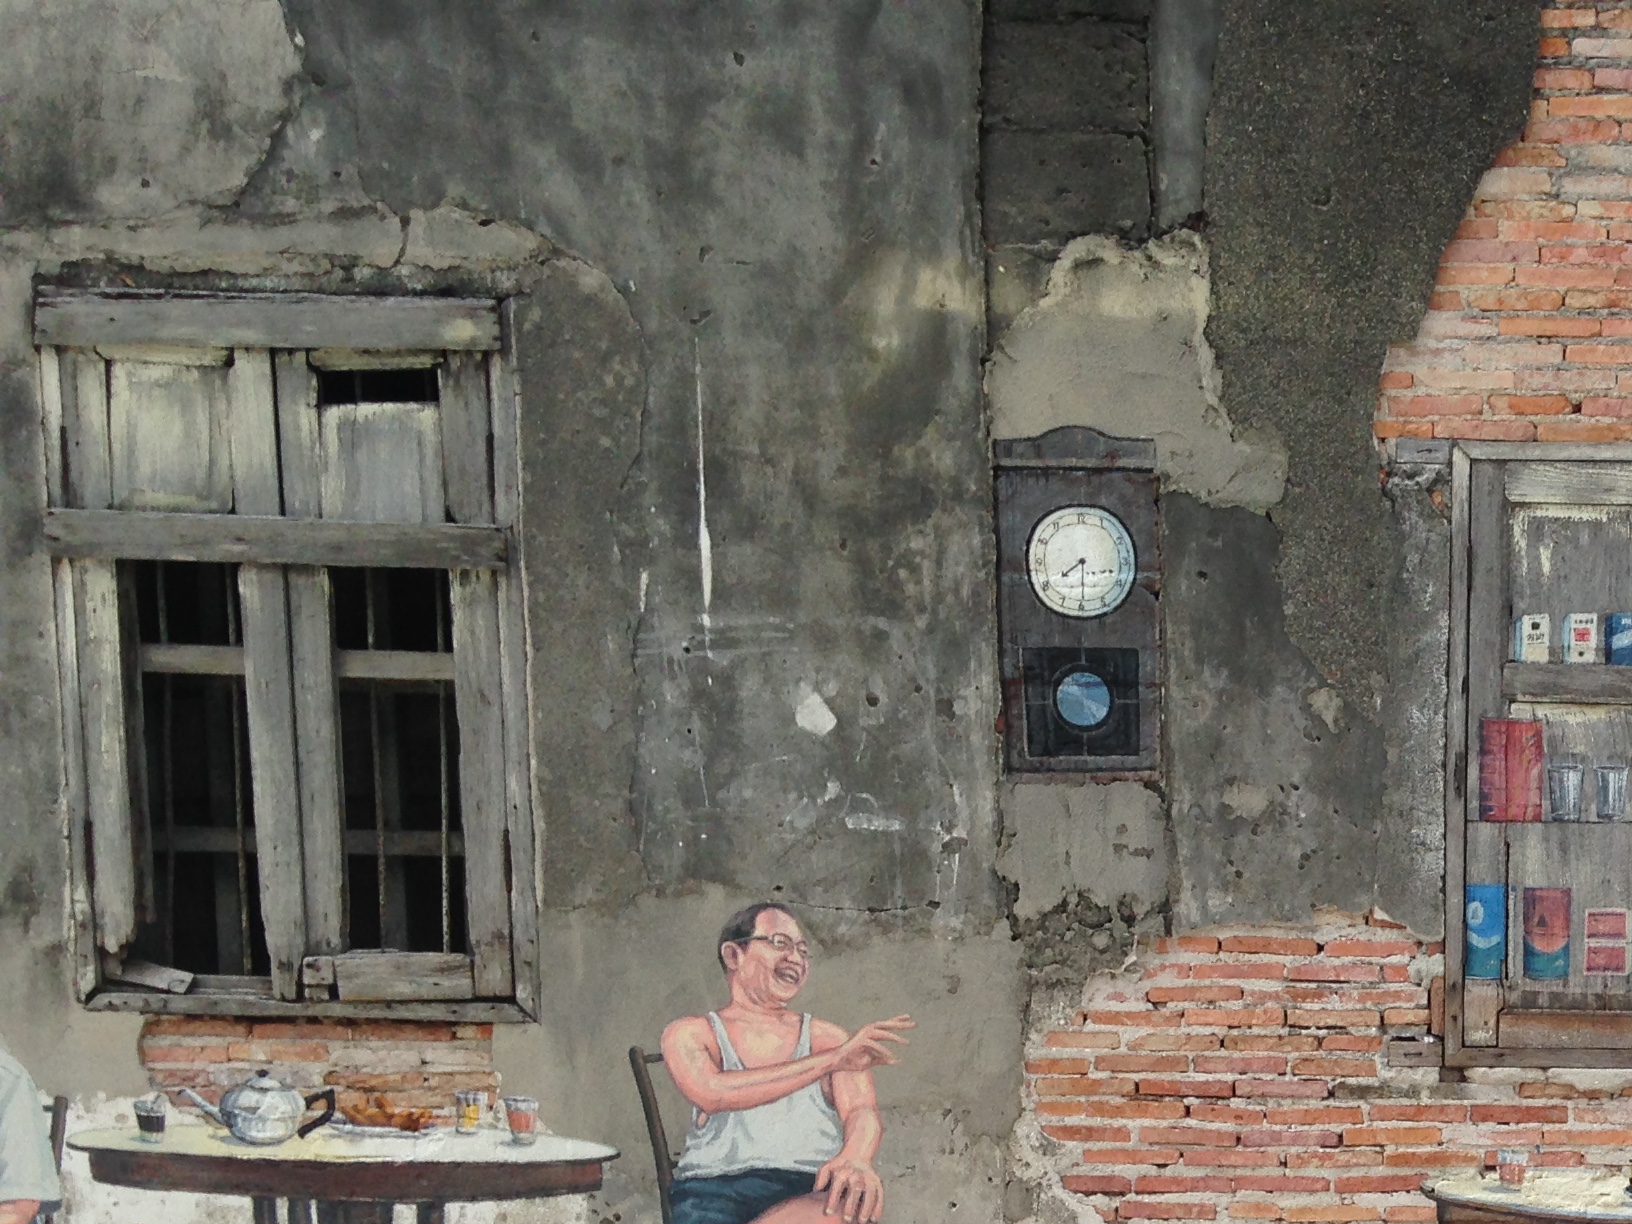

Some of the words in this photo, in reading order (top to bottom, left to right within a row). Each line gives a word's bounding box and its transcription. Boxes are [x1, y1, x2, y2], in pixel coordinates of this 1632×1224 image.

[1036, 557, 1042, 566] 9
[1042, 580, 1049, 591] 8
[1059, 597, 1066, 608] 7
[1078, 601, 1085, 611] 6
